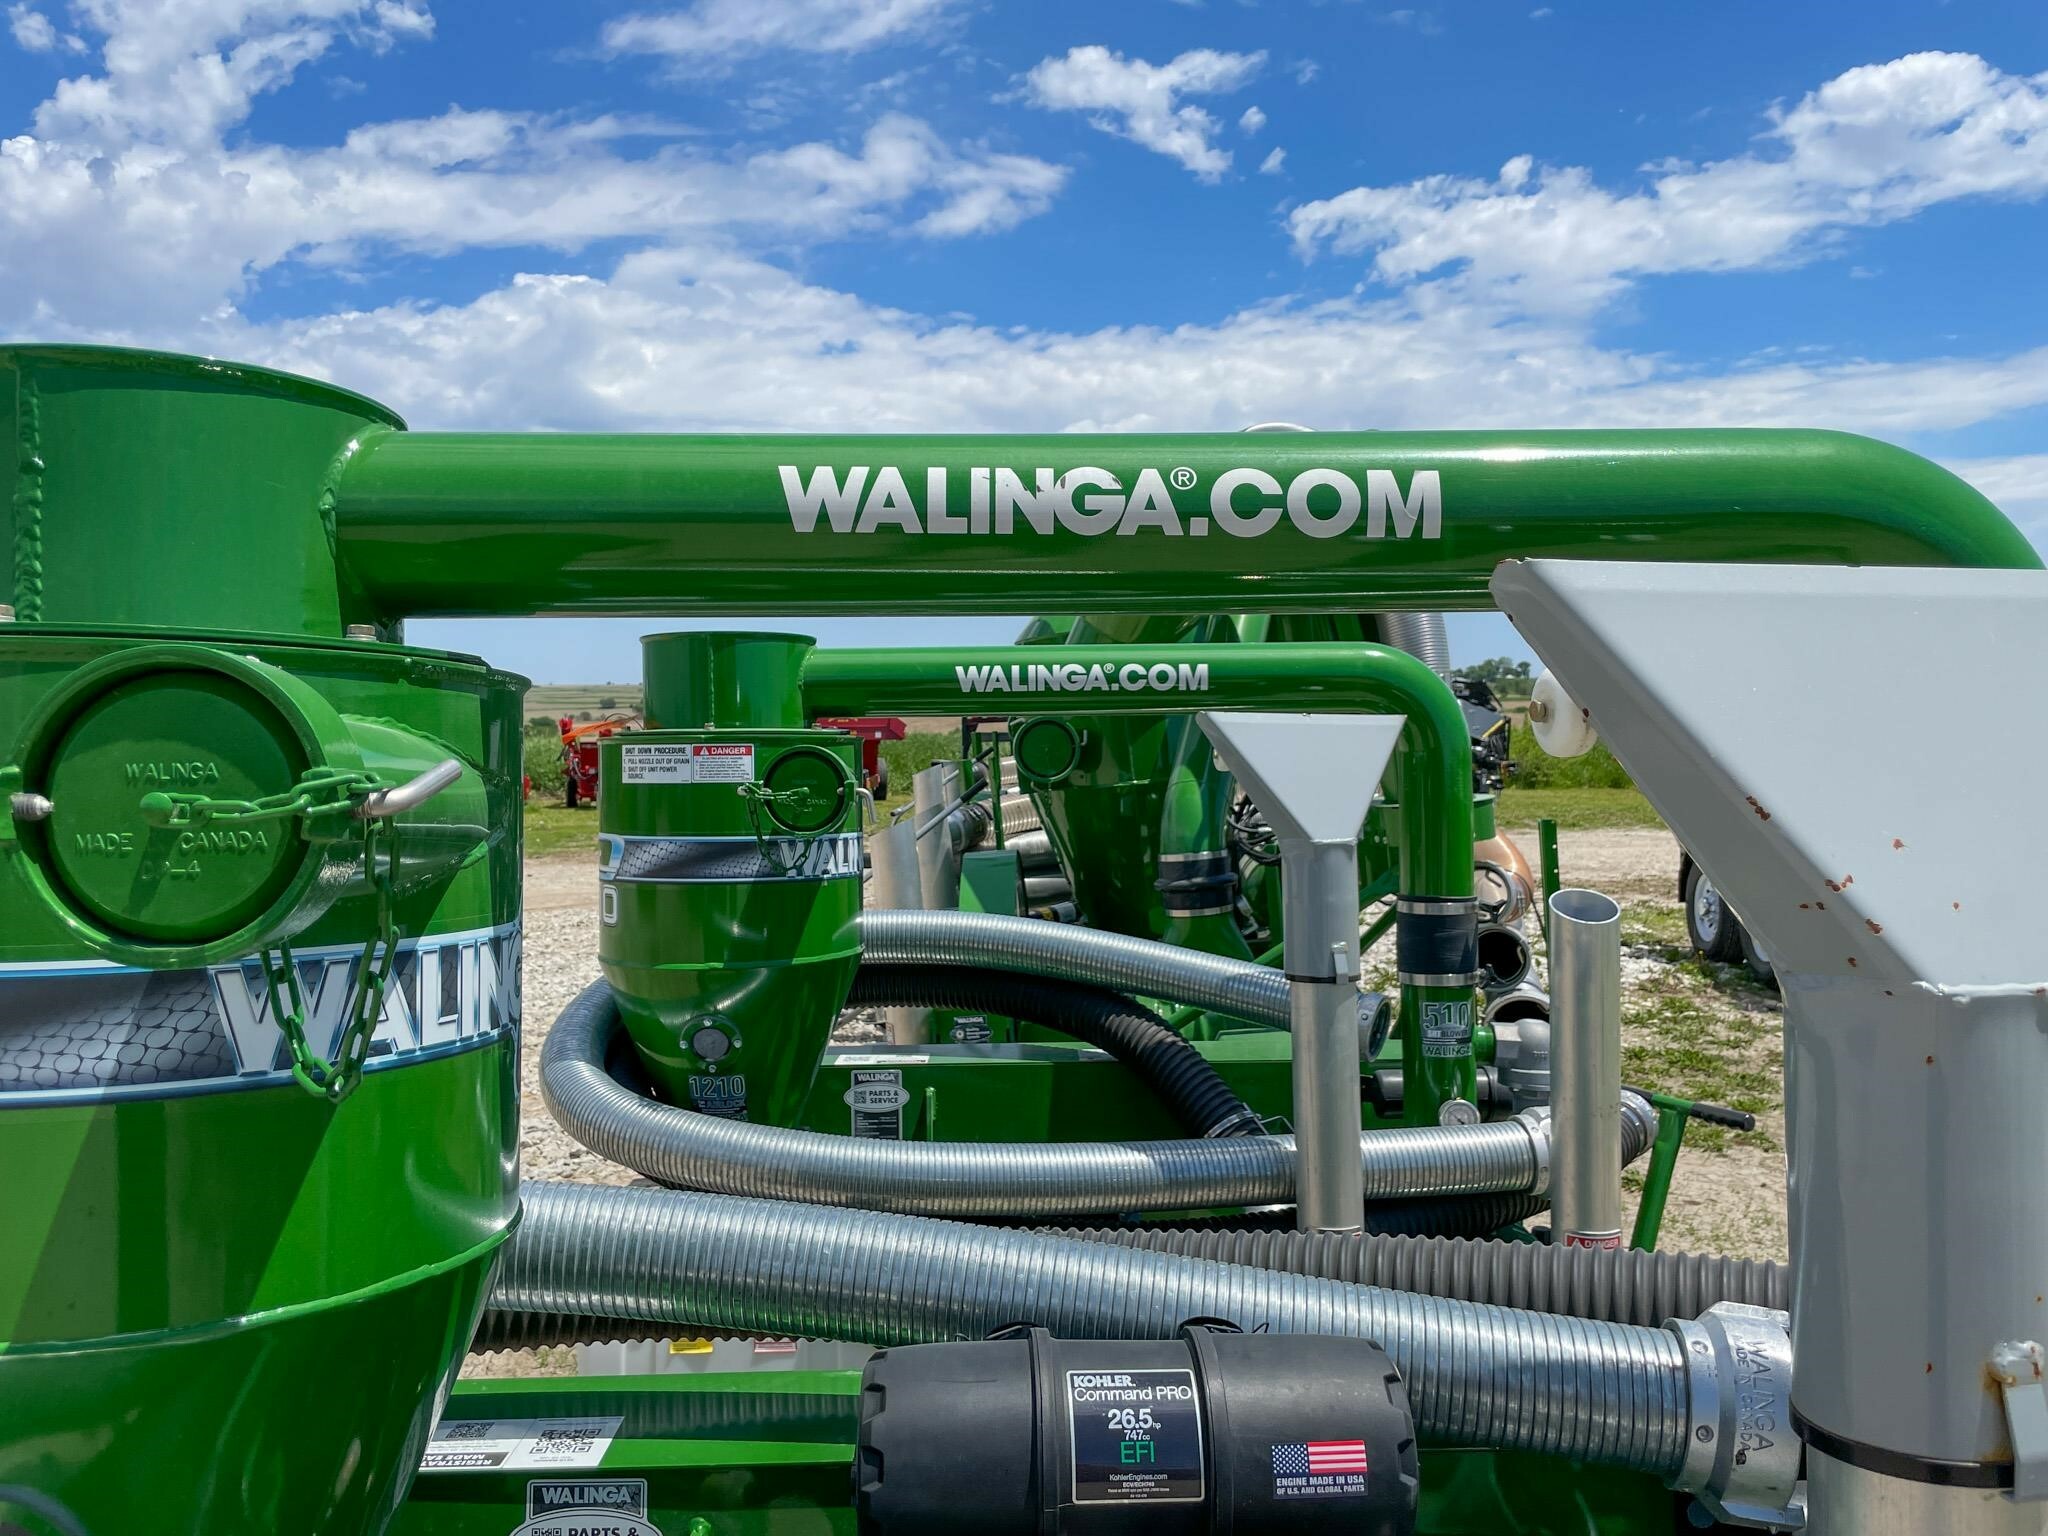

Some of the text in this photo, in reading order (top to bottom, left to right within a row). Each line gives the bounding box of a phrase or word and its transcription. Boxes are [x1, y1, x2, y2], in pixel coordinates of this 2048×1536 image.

[711, 747, 746, 755] DANGER
[126, 762, 219, 780] WALINGA
[76, 831, 268, 850] MADE CANADA
[1423, 1002, 1470, 1030] 510
[857, 1073, 896, 1081] WALINGA
[689, 1075, 746, 1098] 1210
[1074, 1385, 1192, 1401] Command PRO
[1746, 1341, 1776, 1451] WALINGA
[1120, 1441, 1155, 1463] EFI
[1109, 1473, 1168, 1482] KohlerEngines.com
[1276, 1475, 1365, 1486] ENGINE MADE IN USA
[541, 1486, 633, 1504] WALINGA
[1276, 1487, 1286, 1495] OF
[1301, 1486, 1315, 1494] AND
[1316, 1485, 1342, 1493] GLOBAL
[1343, 1484, 1365, 1492] PARTS
[568, 1527, 620, 1536] PARTS
